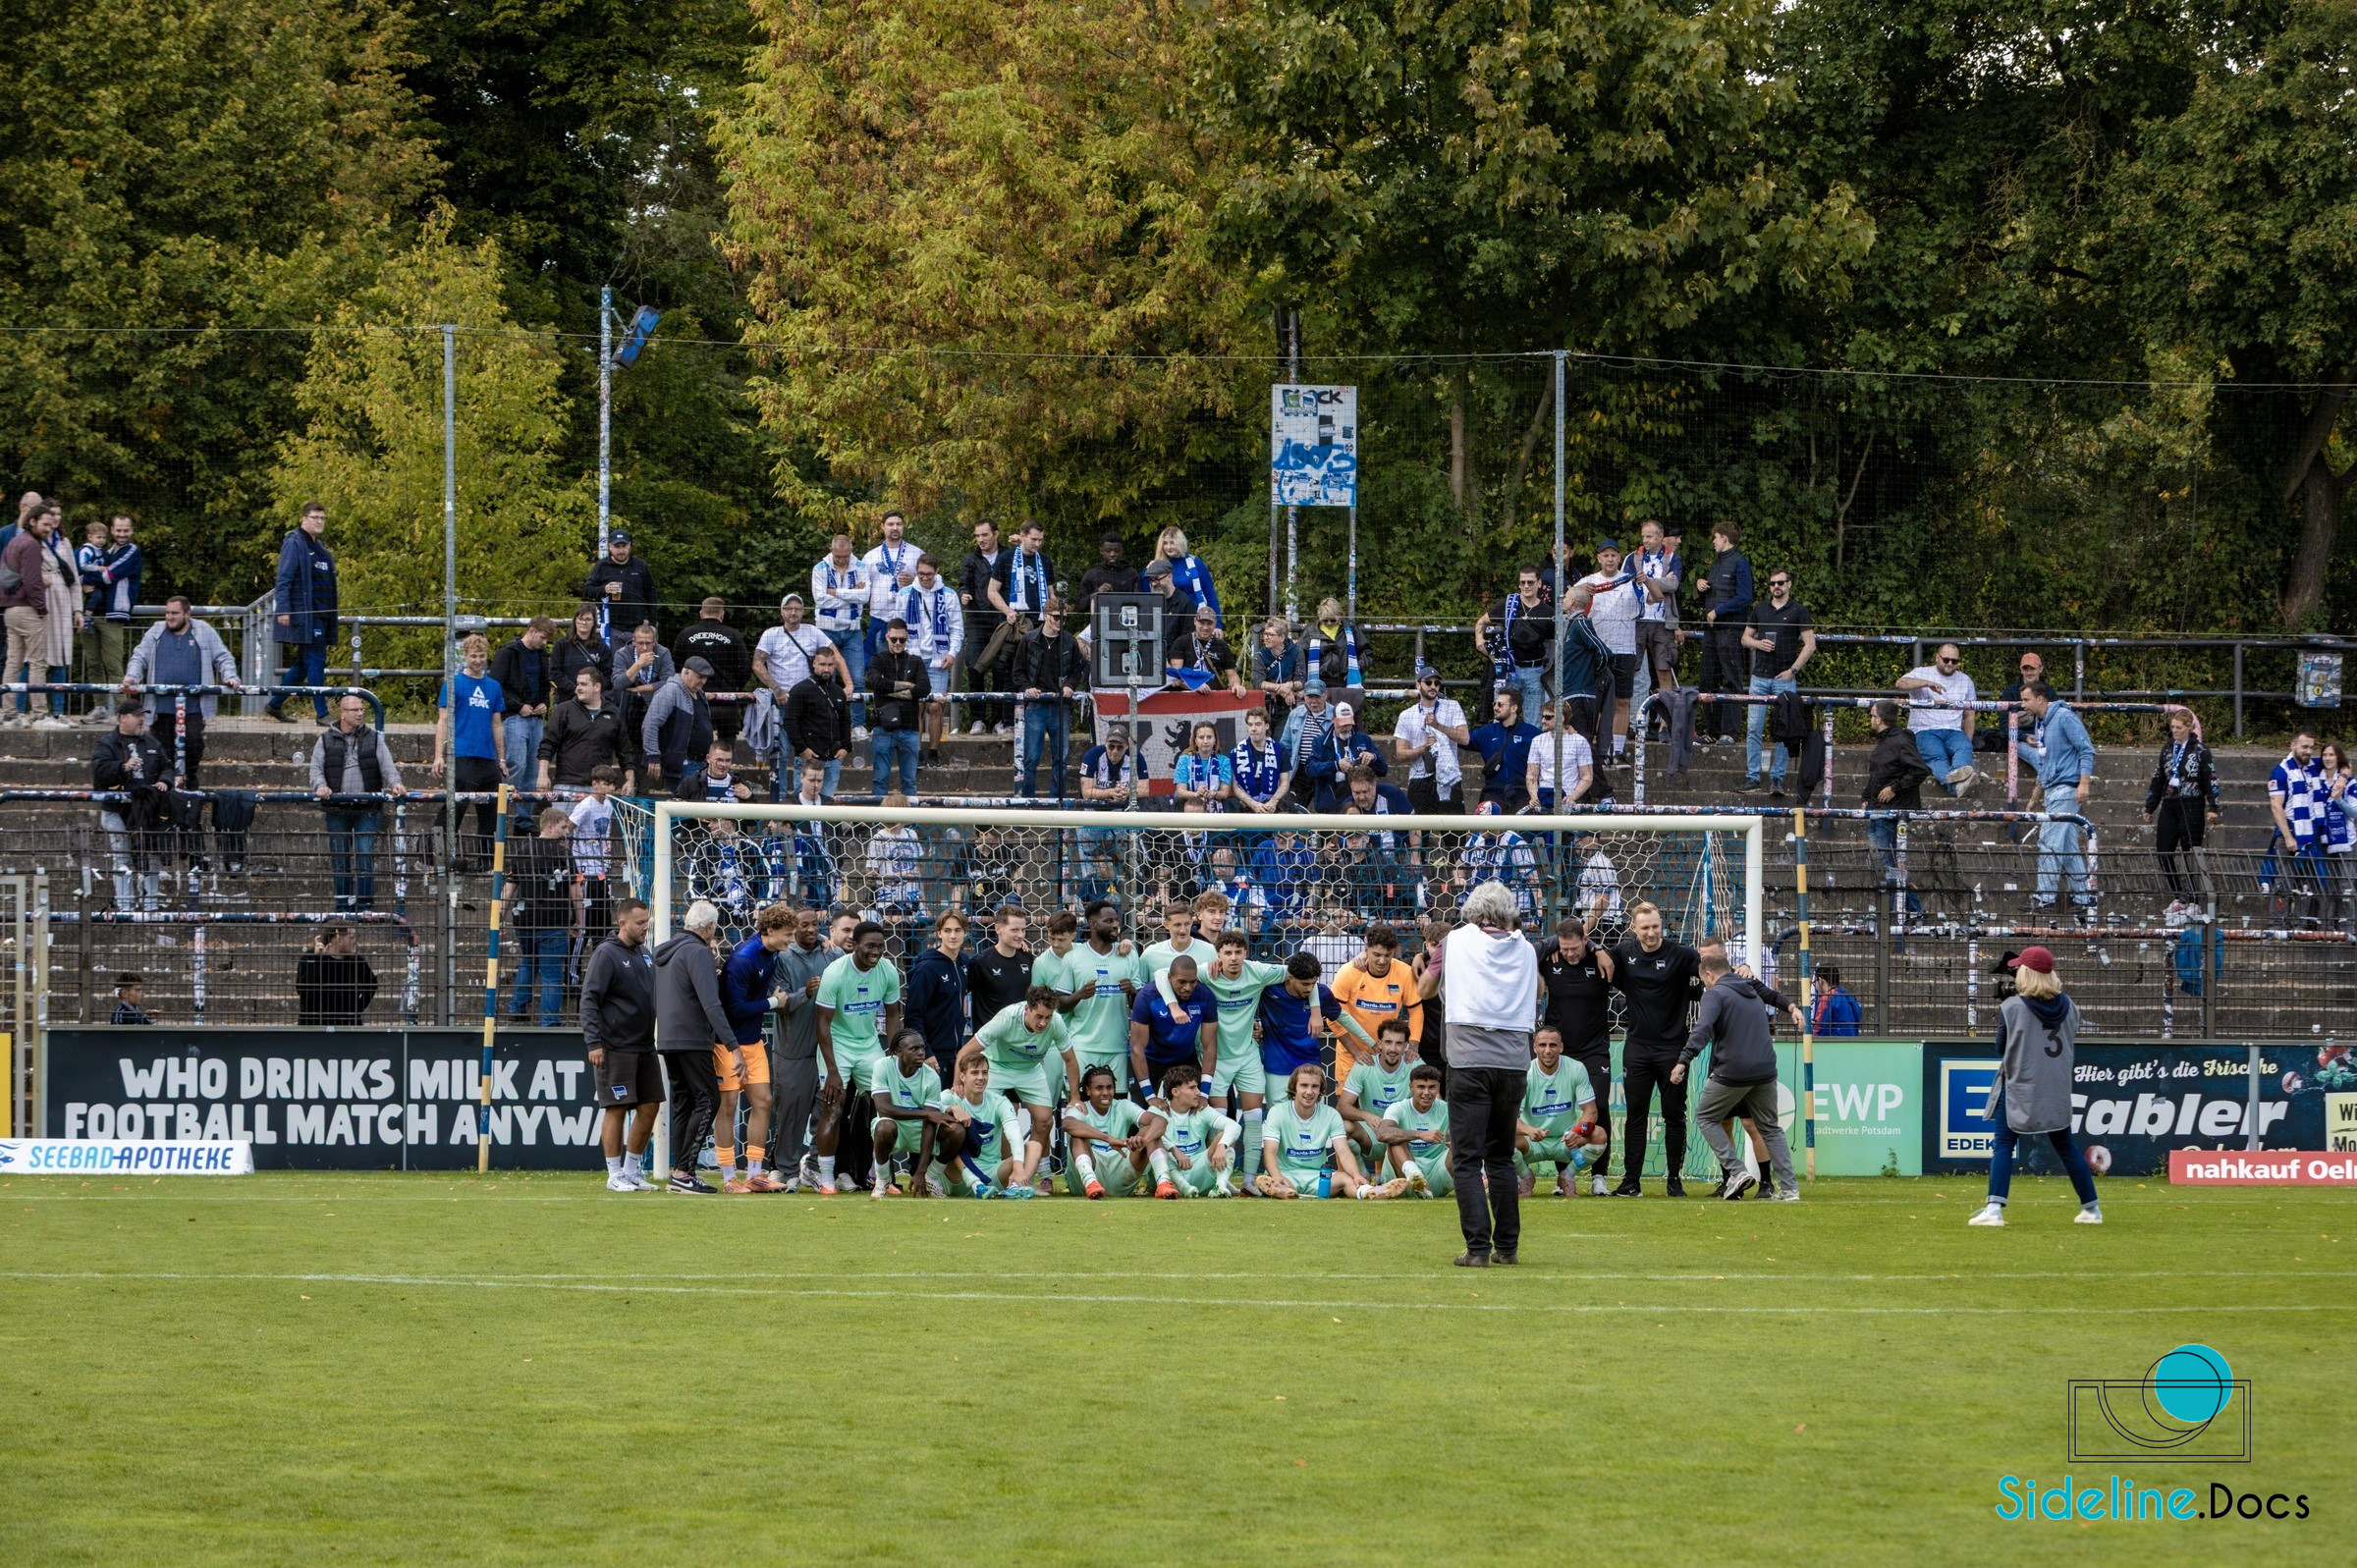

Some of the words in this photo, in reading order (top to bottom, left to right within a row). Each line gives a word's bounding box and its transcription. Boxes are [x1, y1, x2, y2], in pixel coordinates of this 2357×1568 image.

[468, 697, 490, 709] PEAK
[2043, 1023, 2063, 1057] 3
[119, 1057, 228, 1099] WHO
[241, 1057, 395, 1100] DRINKS
[410, 1059, 520, 1100] MILK
[528, 1060, 584, 1100] AT
[2073, 1065, 2114, 1082] Hier
[2117, 1059, 2168, 1087] gibt's
[2172, 1061, 2199, 1078] die
[1813, 1083, 1903, 1121] EWP
[65, 1103, 278, 1144] FOOTBALL
[287, 1104, 438, 1145] MATCH
[1814, 1126, 1859, 1135] tadtwerke
[1861, 1126, 1901, 1135] Potsdam
[28, 1146, 234, 1169] SEEBAD-APOTHEKE
[1947, 1139, 1996, 1151] EDEK
[2186, 1159, 2301, 1179] nahkauf
